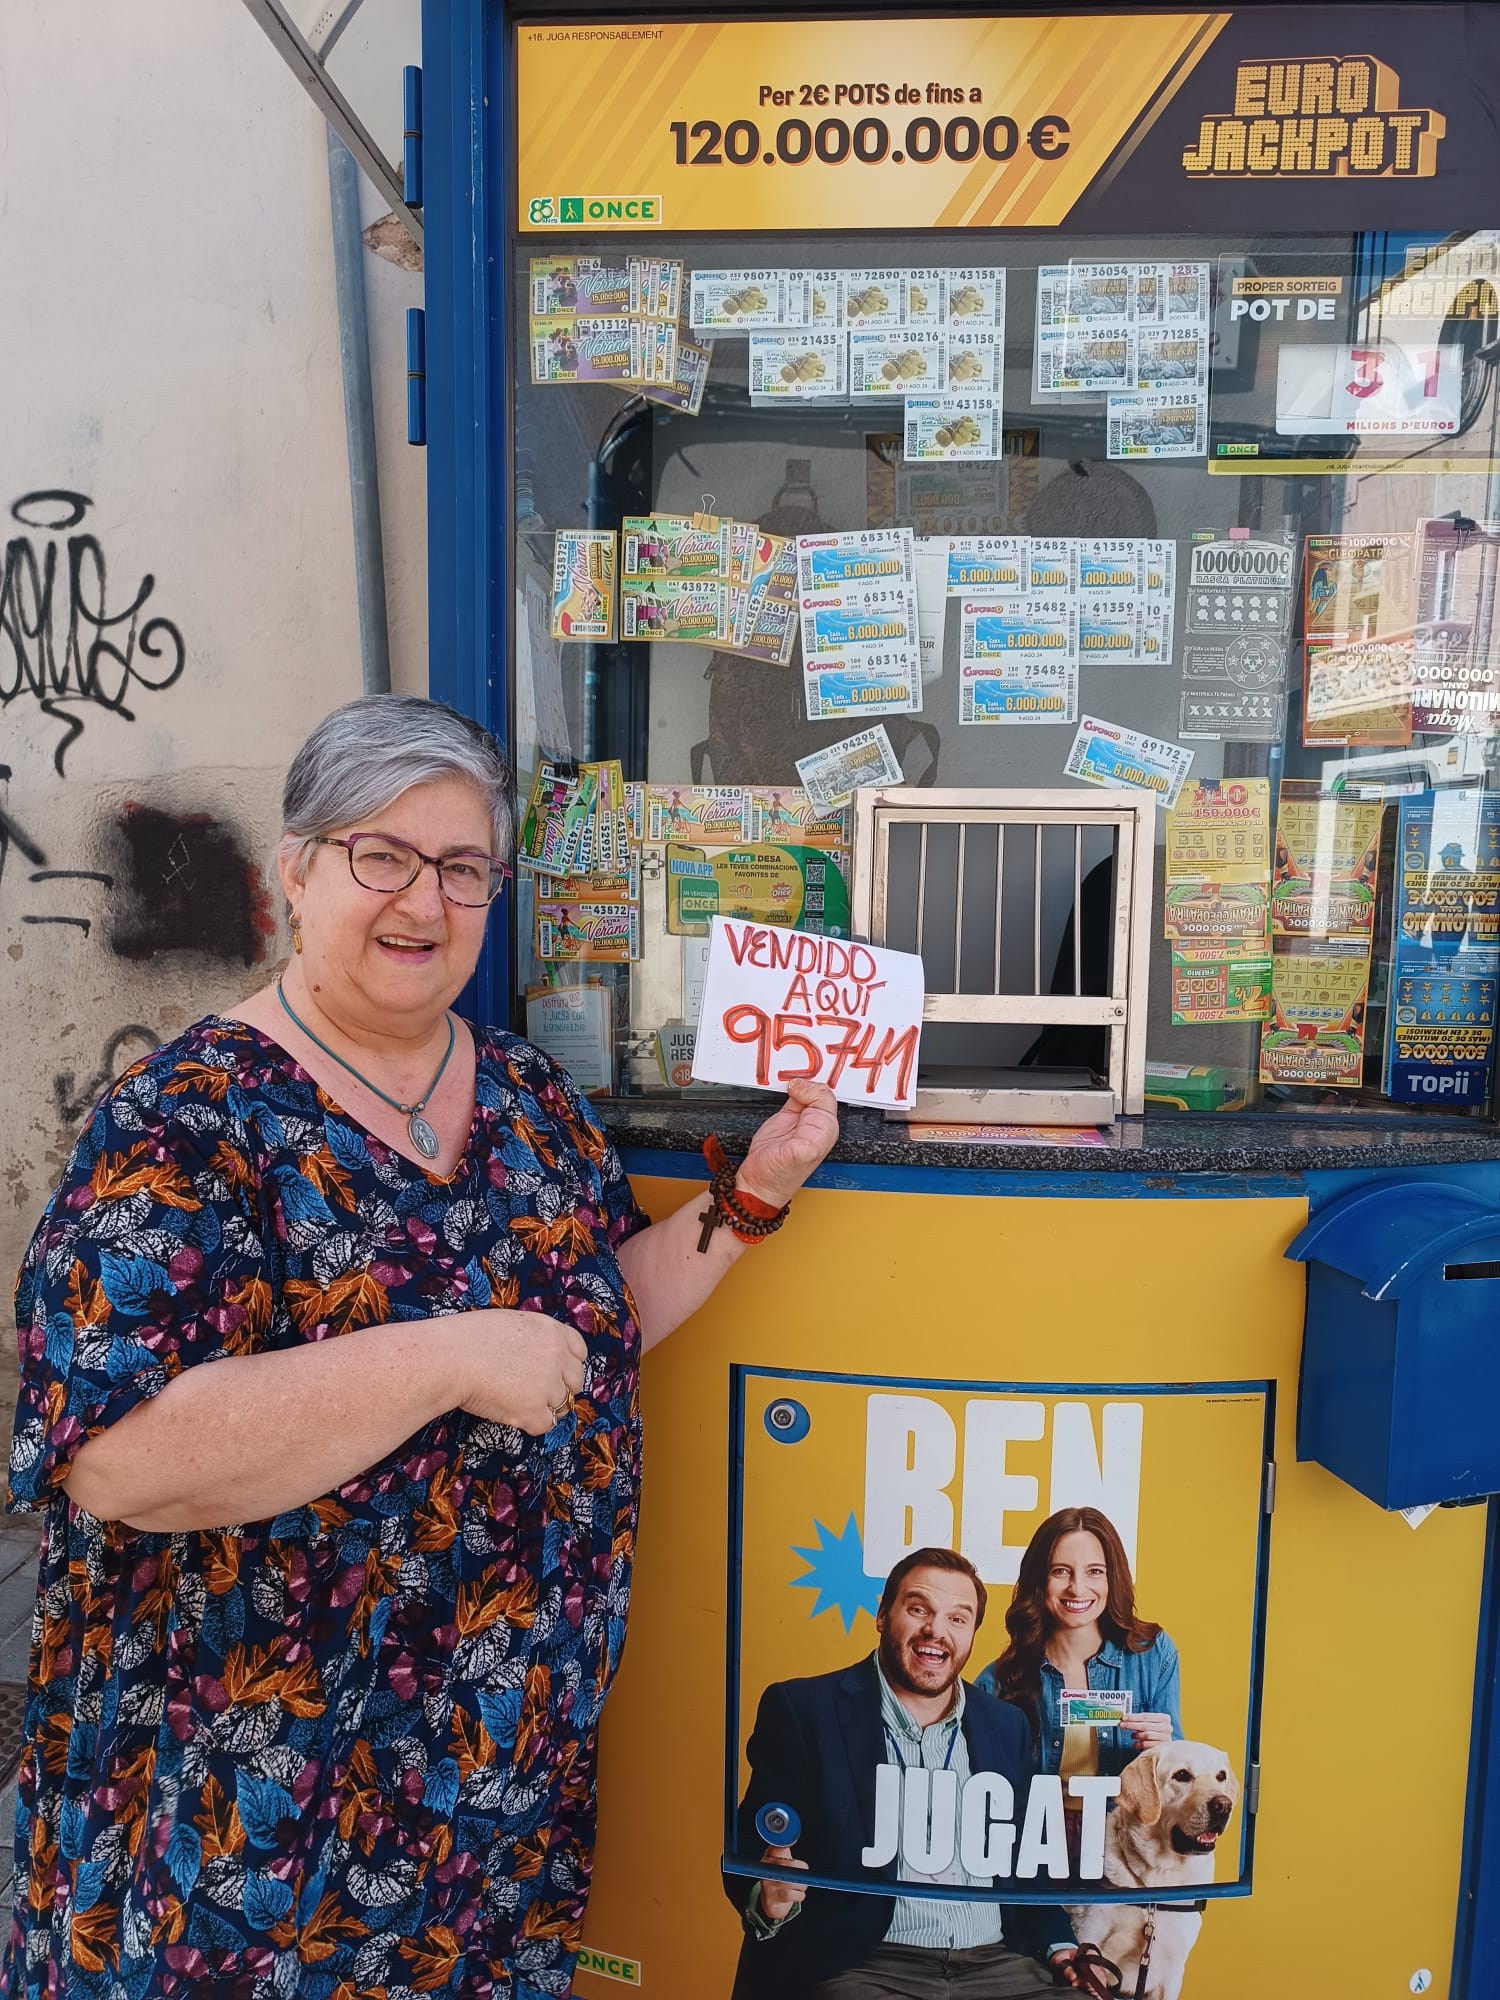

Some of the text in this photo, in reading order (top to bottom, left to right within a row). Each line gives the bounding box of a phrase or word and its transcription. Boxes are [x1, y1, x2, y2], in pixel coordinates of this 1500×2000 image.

[546, 32, 571, 41] JUGA
[571, 30, 663, 41] RESPONSABLEMENT
[759, 82, 982, 106] Per 2€ POTS de fins a
[1235, 62, 1370, 116] EURO
[589, 202, 654, 218] ONCE
[864, 271, 900, 280] 72890
[910, 271, 939, 279] 0216
[960, 271, 995, 279] 43158
[1091, 267, 1128, 276] 36054
[1171, 265, 1199, 275] 1285
[743, 272, 778, 280] 98071
[1237, 282, 1337, 292] PROPER SORTEIG
[1231, 299, 1336, 321] POT DE
[593, 320, 627, 329] 61312
[801, 335, 836, 345] 21435
[903, 332, 938, 342] 30216
[958, 334, 994, 344] 43158
[1091, 329, 1128, 340] 36054
[1163, 329, 1199, 340] 71285
[957, 399, 993, 409] 43158
[1161, 394, 1197, 405] 71285
[1347, 421, 1454, 430] MILIONS D'EUROS
[860, 531, 900, 543] 68314
[1349, 538, 1398, 547] 100.000€
[668, 532, 720, 558] Verano
[977, 540, 1017, 550] 56091
[1093, 542, 1134, 552] 41359
[1328, 548, 1392, 559] CLEOPATRA
[558, 543, 567, 578] 43872
[573, 542, 586, 592] Verano
[1196, 576, 1288, 585] RASCA PLATINUM
[681, 582, 716, 592] 43872
[864, 590, 904, 603] 68314
[667, 593, 718, 620] Verano
[1026, 602, 1066, 612] 75482
[1093, 602, 1134, 613] 41359
[867, 654, 908, 666] 68314
[1025, 665, 1065, 675] 75482
[1412, 688, 1500, 711] MILLONARI
[1427, 710, 1476, 731] Mega
[842, 731, 875, 751] 94298
[1141, 740, 1180, 760] 69172
[1086, 771, 1104, 781] ONCE
[706, 788, 740, 798] 71450
[691, 799, 743, 823] Verano
[1193, 808, 1260, 819] 150.000€
[544, 810, 564, 863] Verano
[601, 824, 611, 859] 52939
[617, 819, 628, 856] 43872
[562, 830, 578, 865] 43872
[580, 827, 593, 863] 43872
[734, 854, 751, 862] Ara
[672, 860, 713, 876] NOVA APP
[1408, 889, 1497, 906] 500.000€
[686, 899, 715, 909] ONCE
[593, 905, 626, 915] 43872
[1230, 905, 1261, 924] GRAN
[1402, 912, 1499, 932] MILLONARIO
[579, 916, 628, 940] Verano
[1182, 924, 1233, 932] 500.000€
[1194, 1010, 1224, 1020] 7.500€
[722, 1003, 919, 1101] 95741
[1399, 1044, 1487, 1060] 500.000€
[1326, 1052, 1357, 1072] GRAN
[675, 1069, 690, 1080] +18
[1277, 1069, 1327, 1079] 500.000€
[862, 1394, 1144, 1585] BEN
[1100, 1692, 1126, 1700] 00000
[861, 1763, 1121, 1881] JUGAT
[577, 1950, 634, 1980] ONCE
